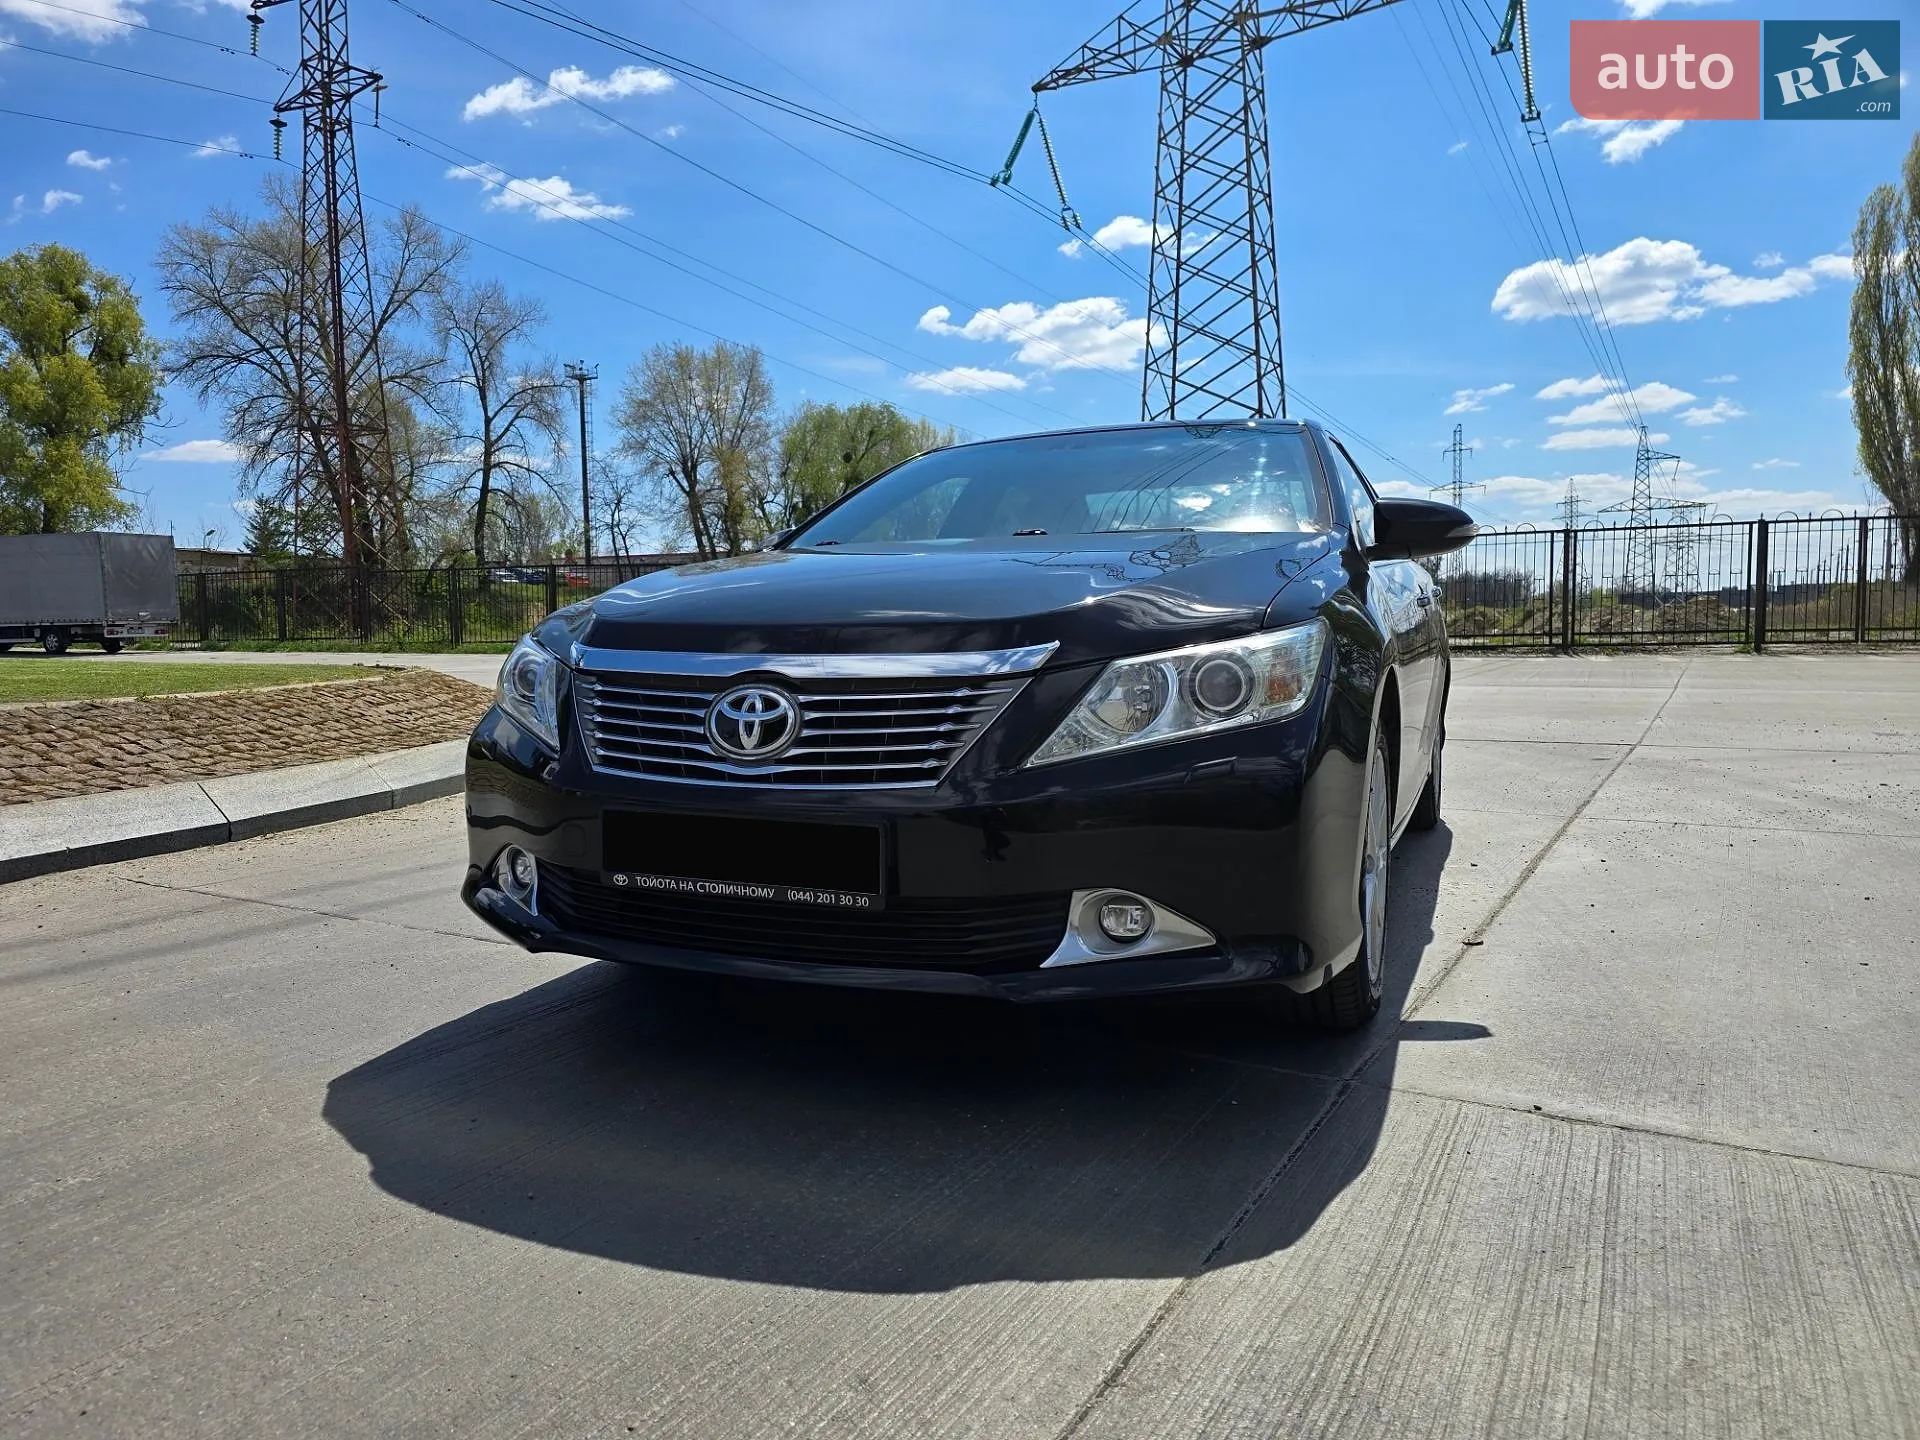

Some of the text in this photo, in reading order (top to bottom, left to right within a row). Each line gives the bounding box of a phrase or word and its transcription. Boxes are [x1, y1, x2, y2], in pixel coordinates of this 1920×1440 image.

[635, 875, 869, 907] ТОЙОТА НА СТОЛИЧНОМУ (044) 201 30 30
